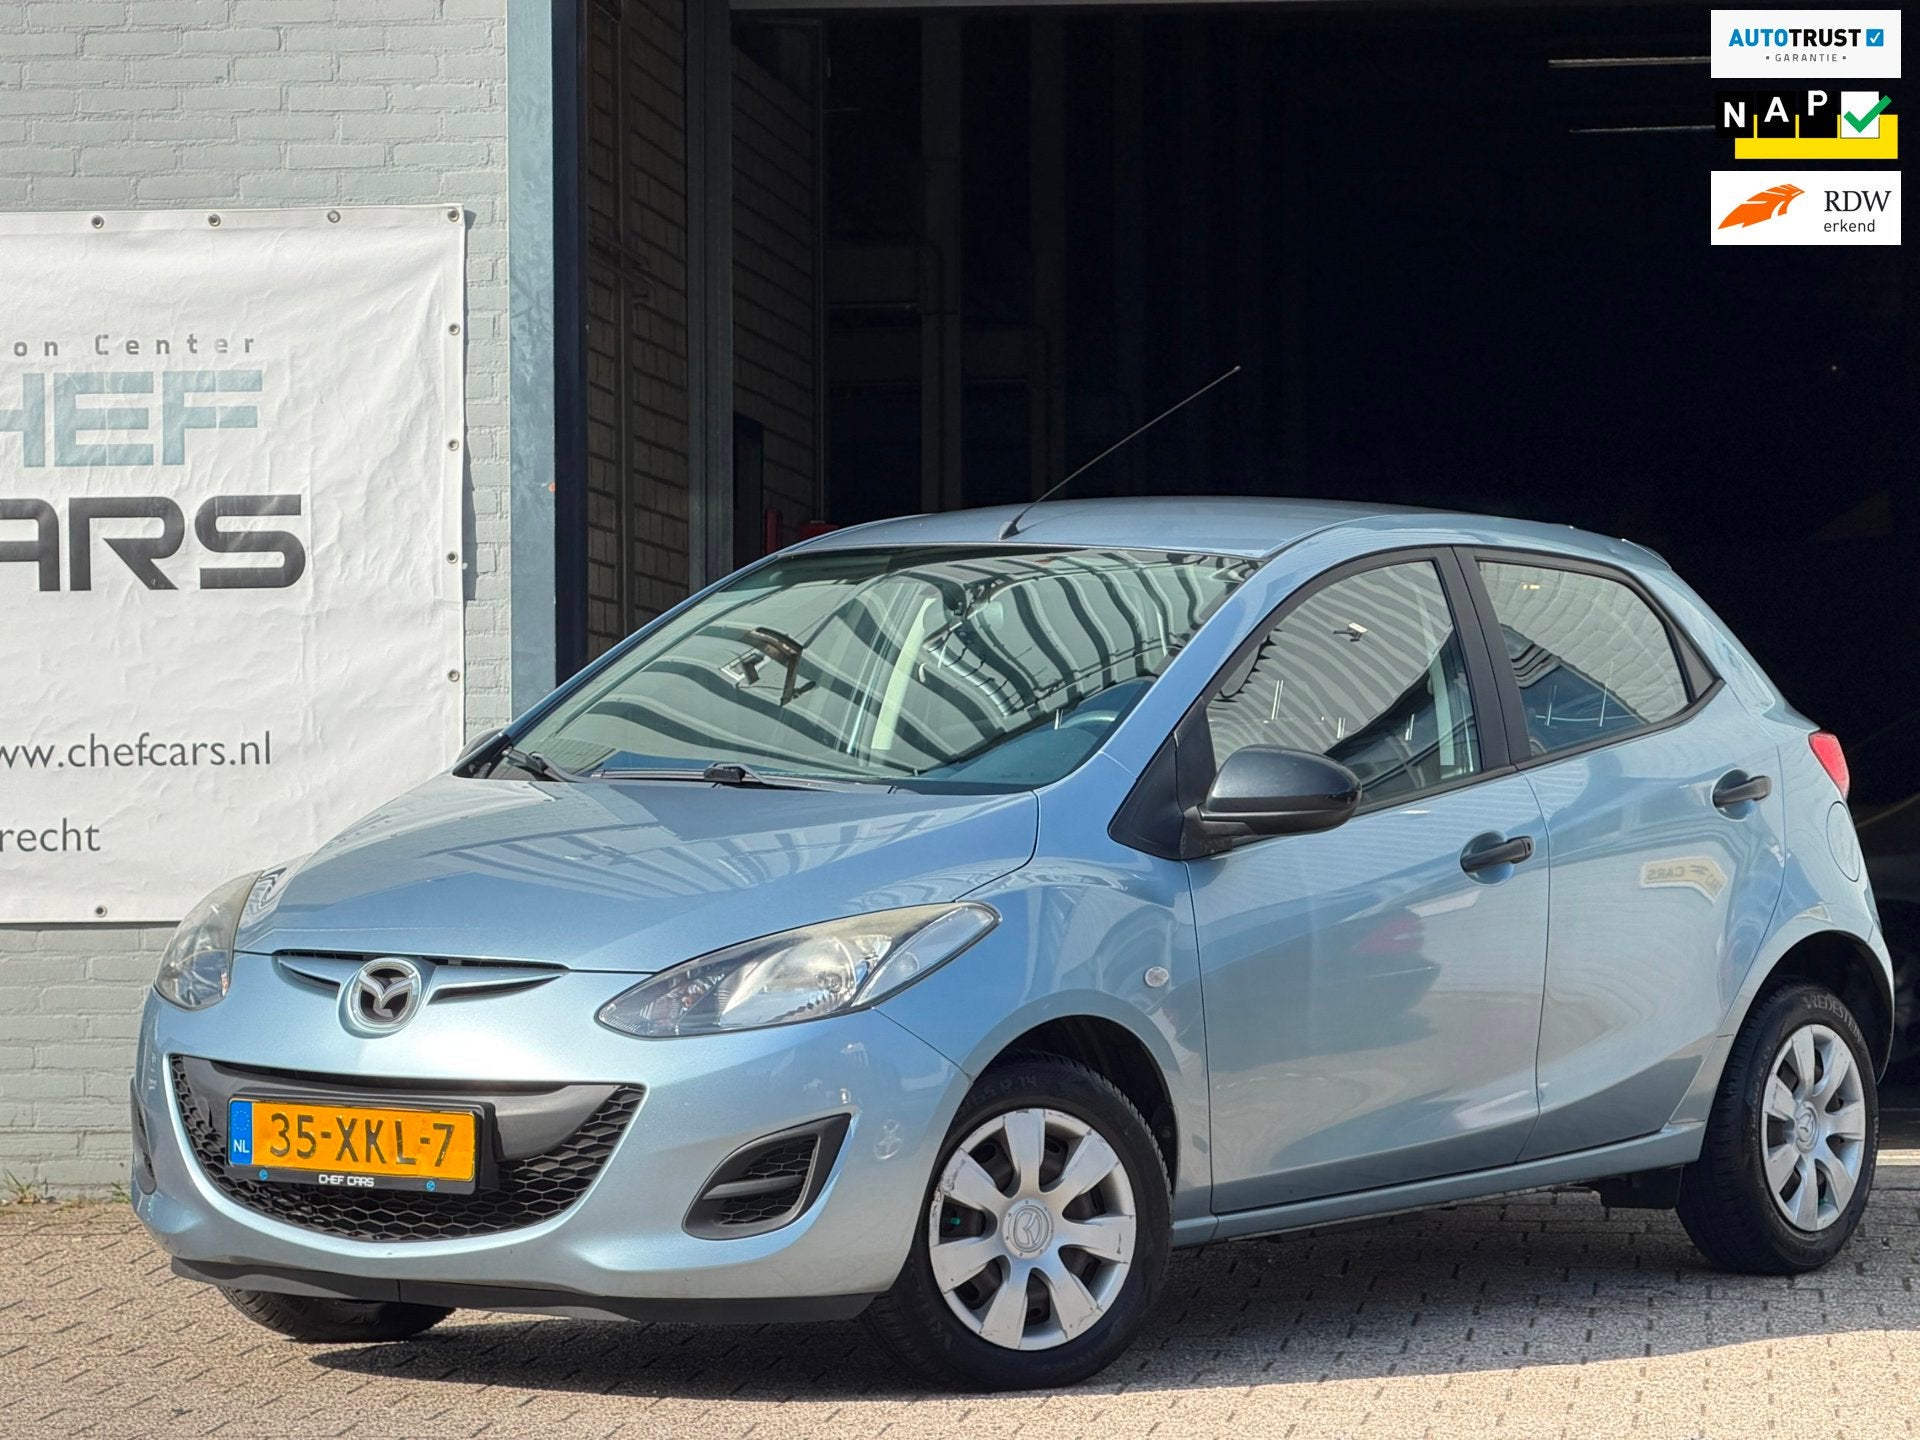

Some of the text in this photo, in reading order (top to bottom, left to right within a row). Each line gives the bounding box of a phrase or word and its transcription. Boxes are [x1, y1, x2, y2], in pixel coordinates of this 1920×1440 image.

[94, 333, 255, 356] Center
[0, 817, 101, 852] recht
[233, 1139, 250, 1154] NL
[269, 1112, 455, 1168] 35-XKL-7
[318, 1173, 375, 1188] CHEF CARS
